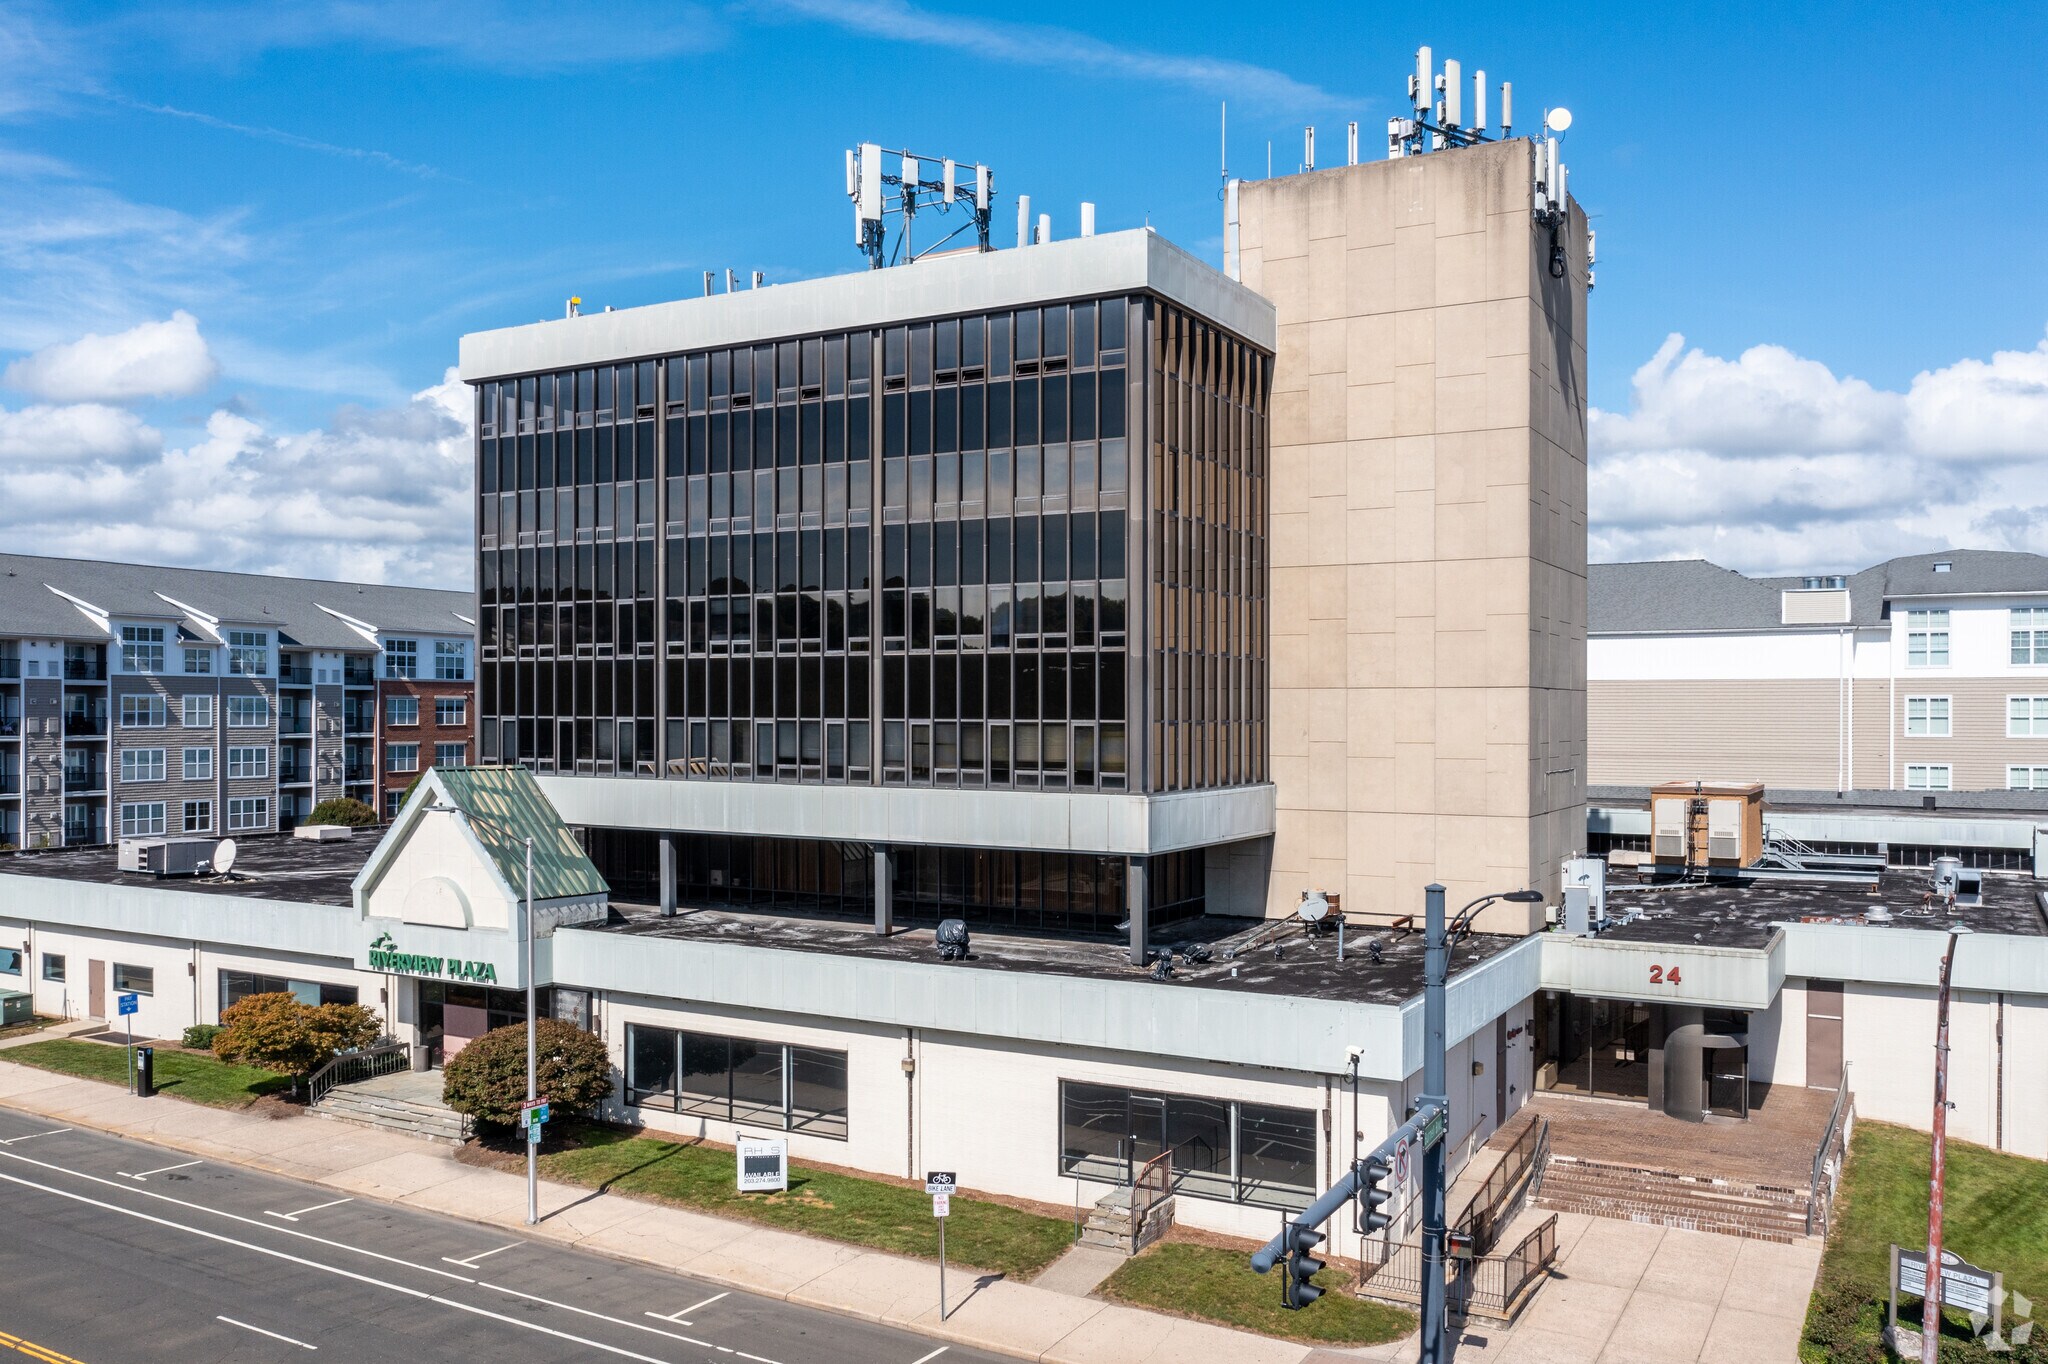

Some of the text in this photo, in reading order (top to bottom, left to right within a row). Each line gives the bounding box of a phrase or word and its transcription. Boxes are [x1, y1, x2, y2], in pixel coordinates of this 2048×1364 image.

[369, 950, 498, 981] RIVERVIEW PLAZA
[1649, 964, 1682, 986] 24
[1953, 1272, 1978, 1284] PLAZA
